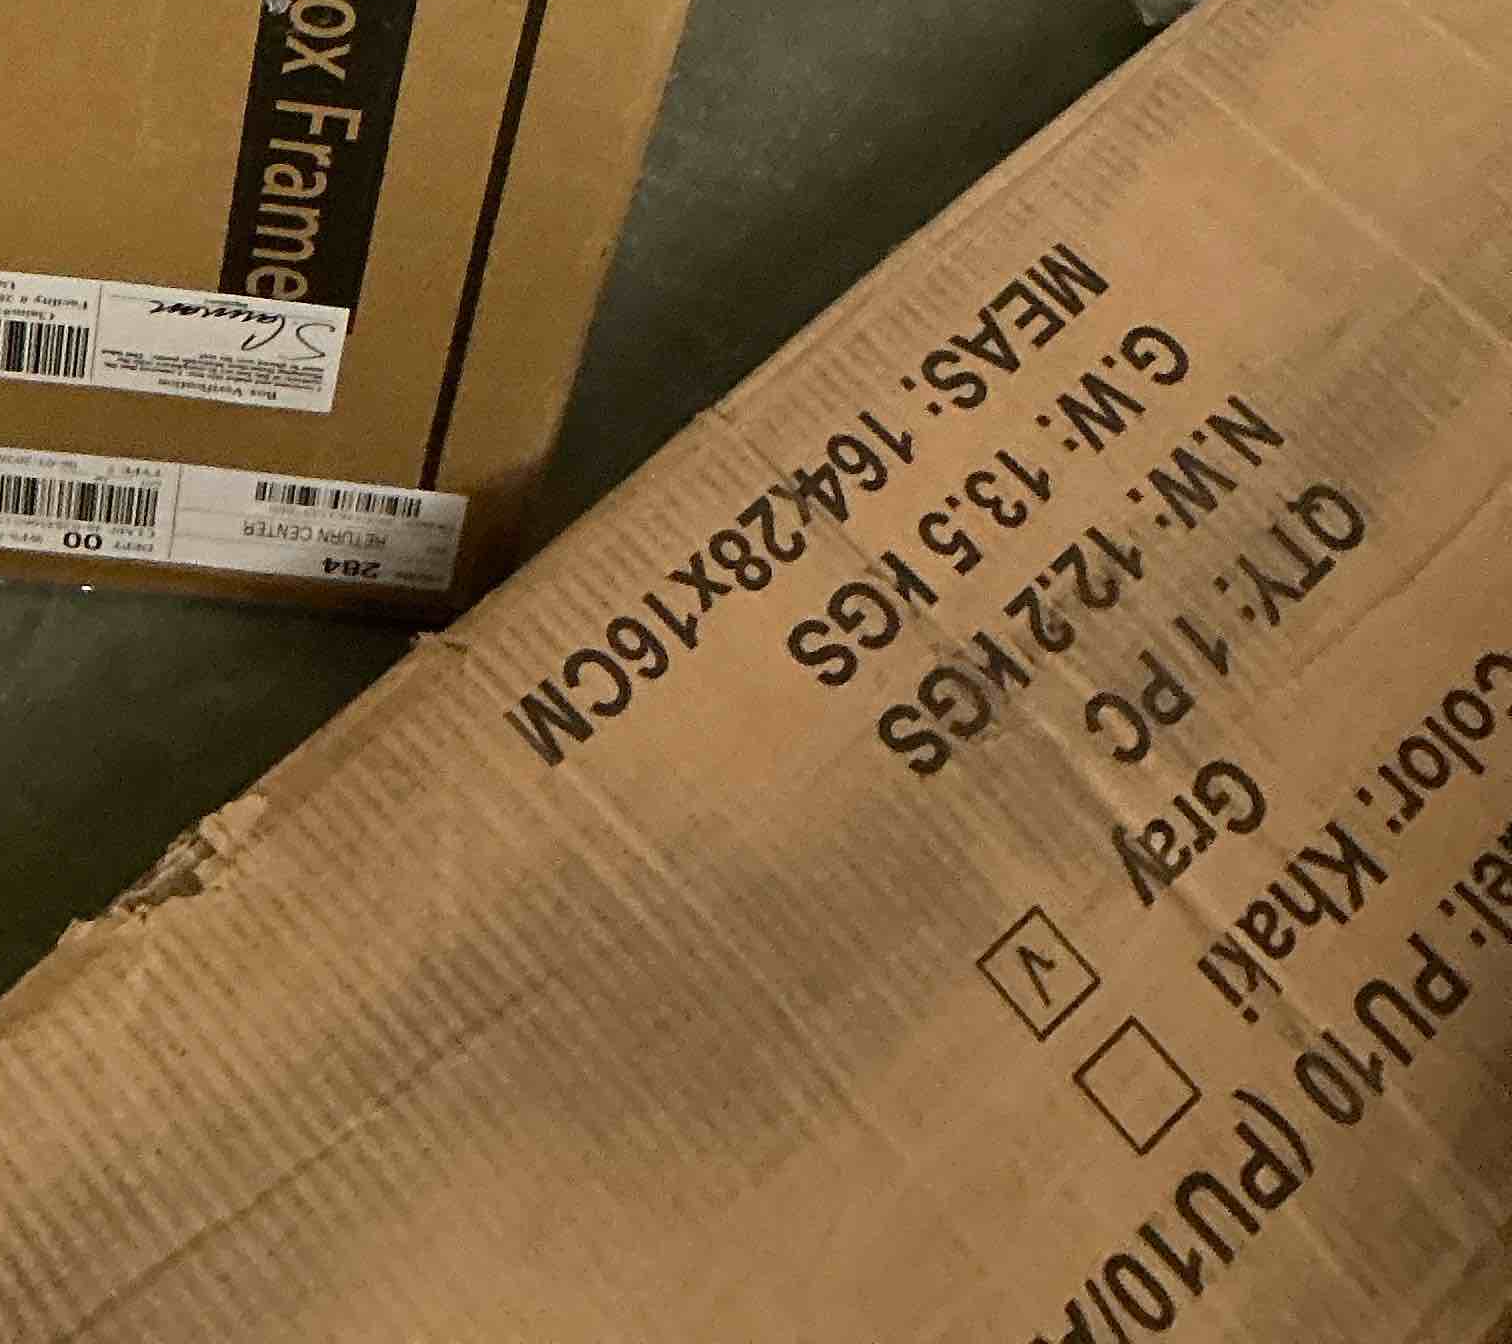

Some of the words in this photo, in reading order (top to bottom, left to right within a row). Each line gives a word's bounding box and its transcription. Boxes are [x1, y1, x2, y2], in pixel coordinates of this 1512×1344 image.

[245, 100, 362, 299] Frame
[904, 244, 1109, 415] MEAS:
[1035, 327, 1190, 453] G.W:
[918, 448, 1053, 575] 13.5
[1127, 394, 1287, 534] N.W:
[62, 531, 102, 551] 00
[240, 519, 313, 541] CENTER
[317, 526, 387, 547] RETURN
[321, 556, 381, 579] 284
[1004, 527, 1150, 653] 12.2
[1215, 483, 1368, 626] QTY:
[787, 550, 938, 687] KGS
[1174, 615, 1230, 678] 1
[879, 631, 1033, 777] KGS
[1084, 651, 1195, 765] PC
[1112, 759, 1267, 908] Gray
[1438, 818, 1512, 946] el:
[1196, 820, 1388, 1024] Khaki
[1293, 932, 1472, 1127] PU10
